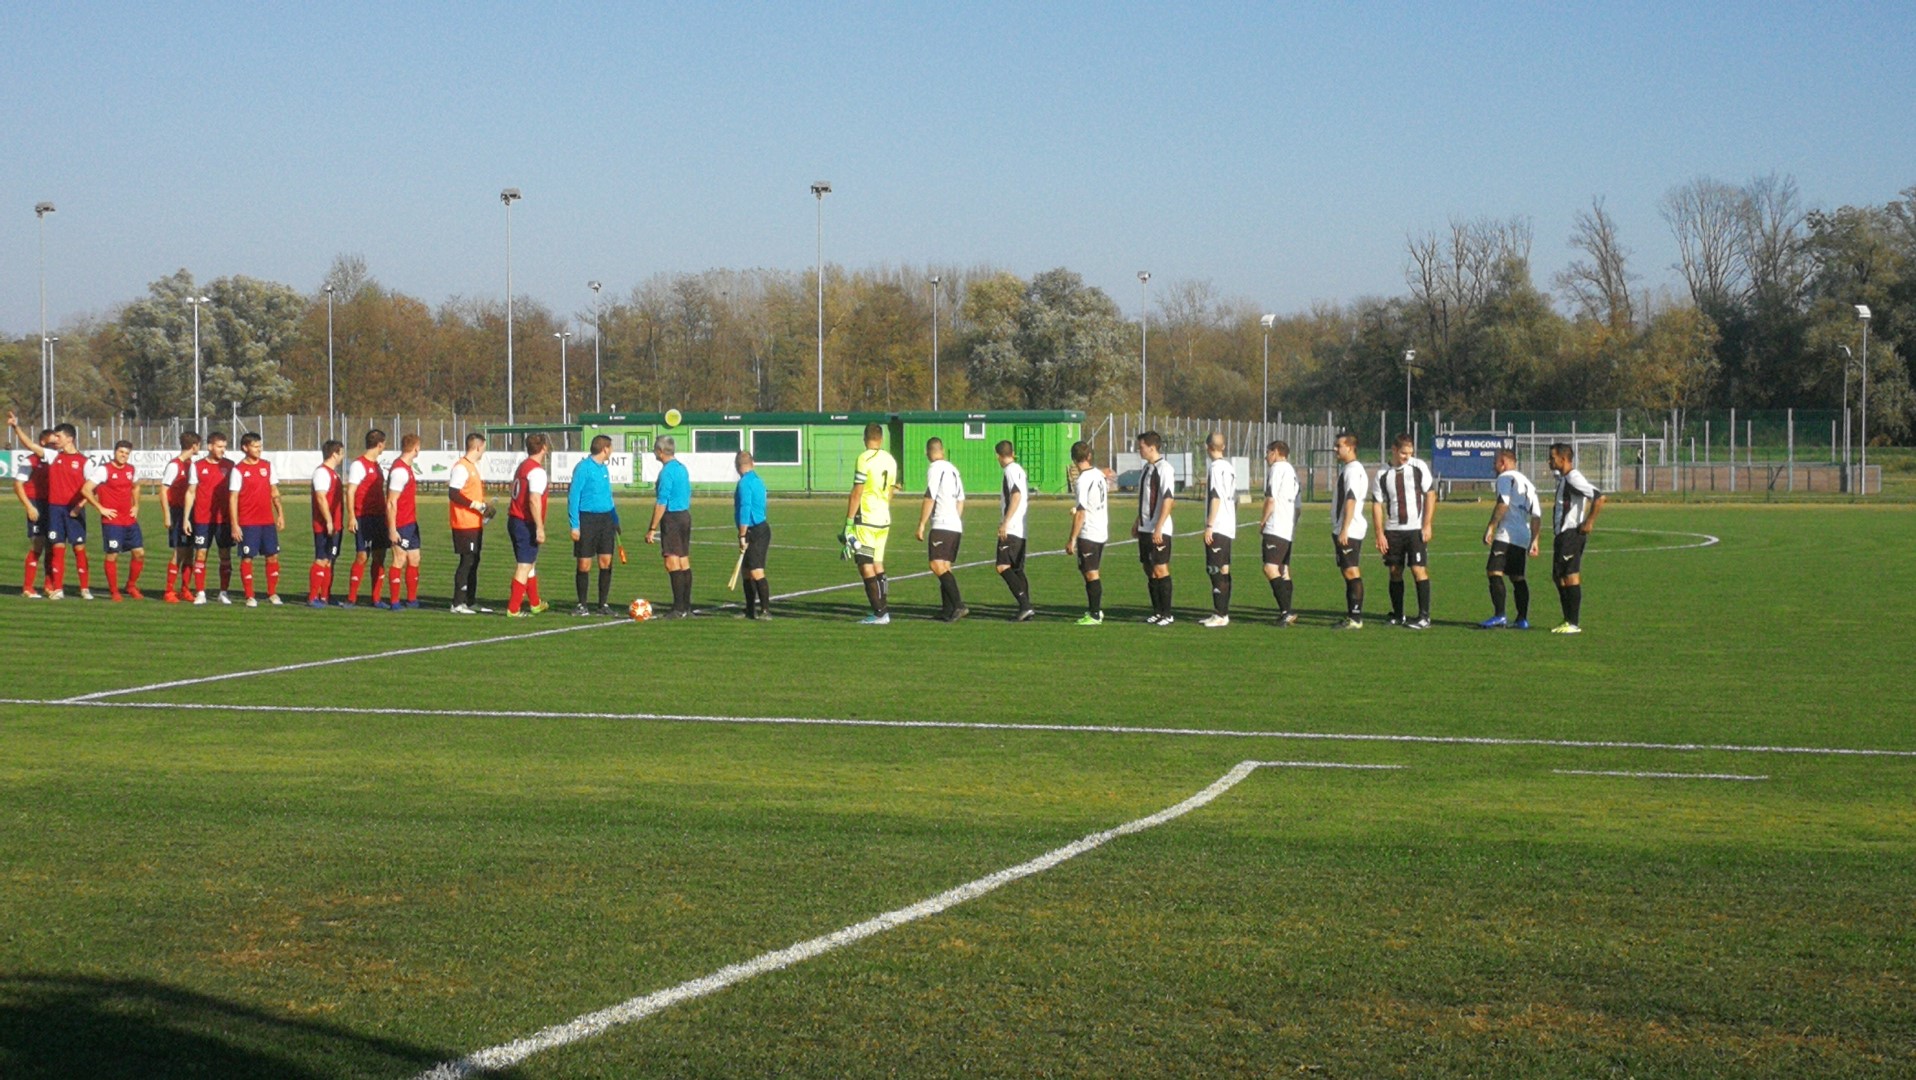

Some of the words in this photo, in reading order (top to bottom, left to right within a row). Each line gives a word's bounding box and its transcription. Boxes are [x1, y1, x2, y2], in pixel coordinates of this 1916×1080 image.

[1447, 438, 1462, 449] ŠNK
[1464, 440, 1502, 449] RADGONA
[133, 451, 173, 463] CASINO
